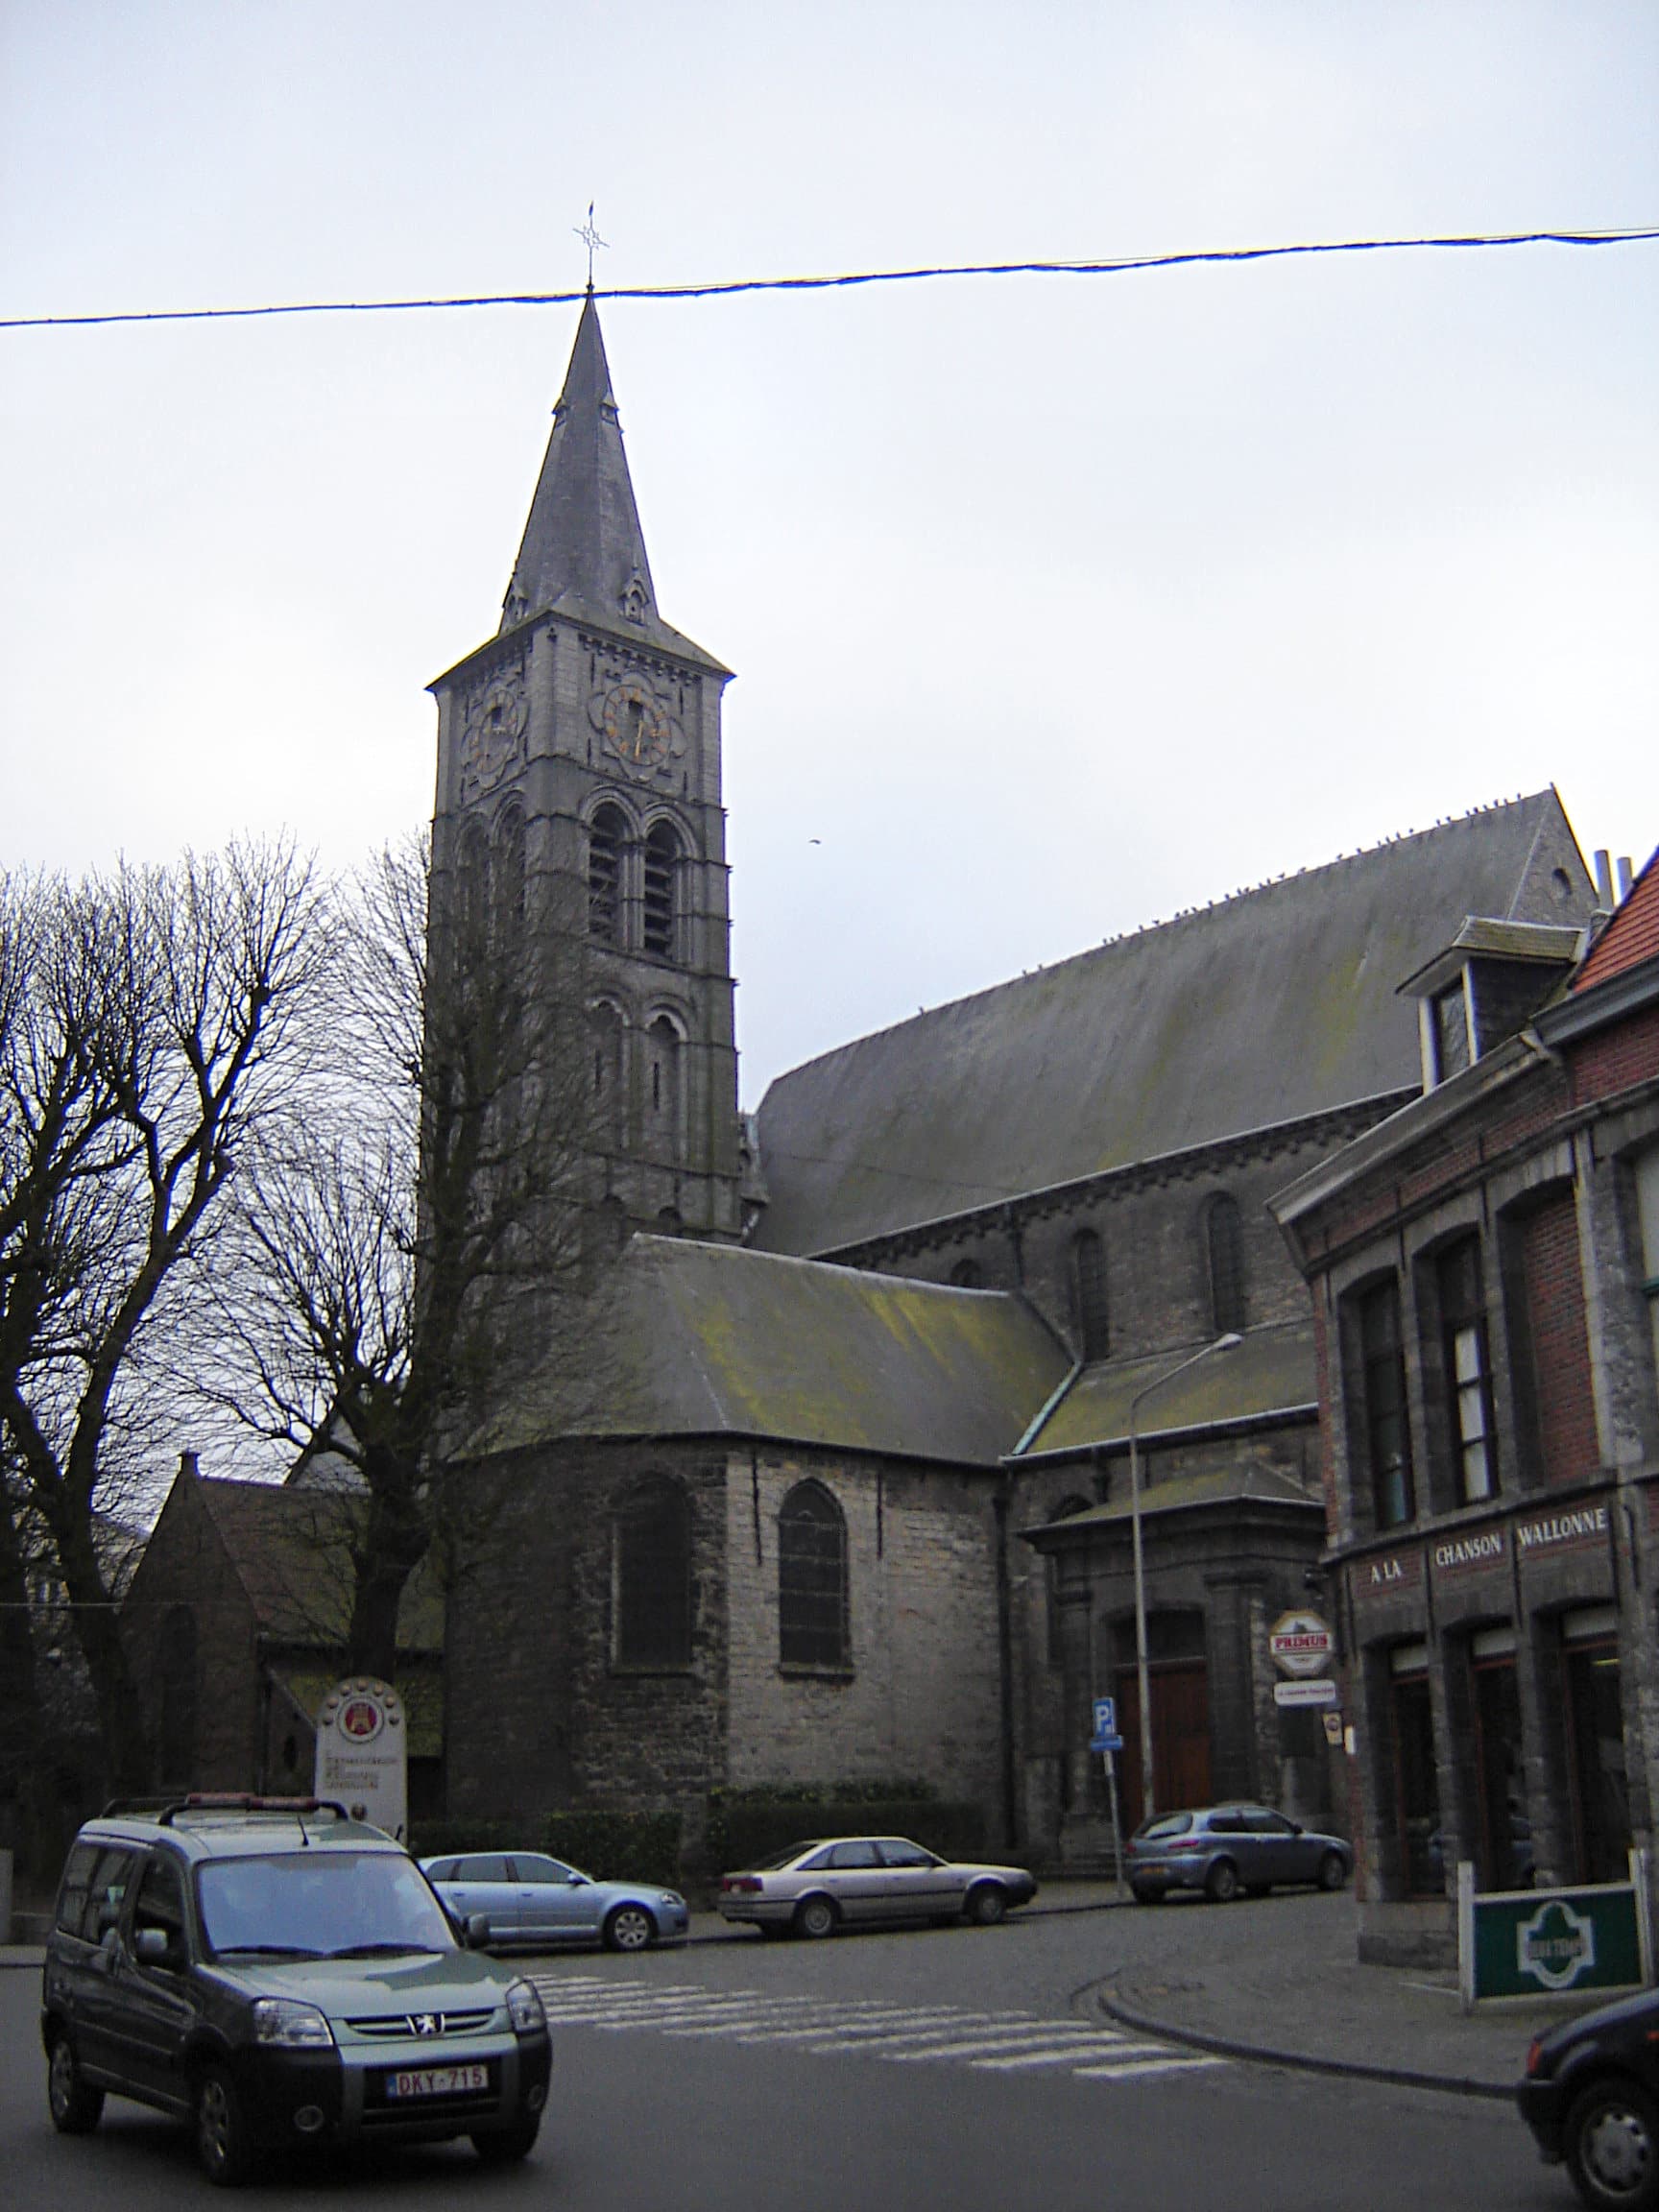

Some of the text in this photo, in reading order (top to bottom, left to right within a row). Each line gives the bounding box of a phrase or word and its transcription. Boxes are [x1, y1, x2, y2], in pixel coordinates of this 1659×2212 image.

[1371, 1508, 1606, 1583] A LA CHANSON WALLONNE
[1274, 1634, 1328, 1649] PRIMUS
[1095, 1704, 1110, 1734] P
